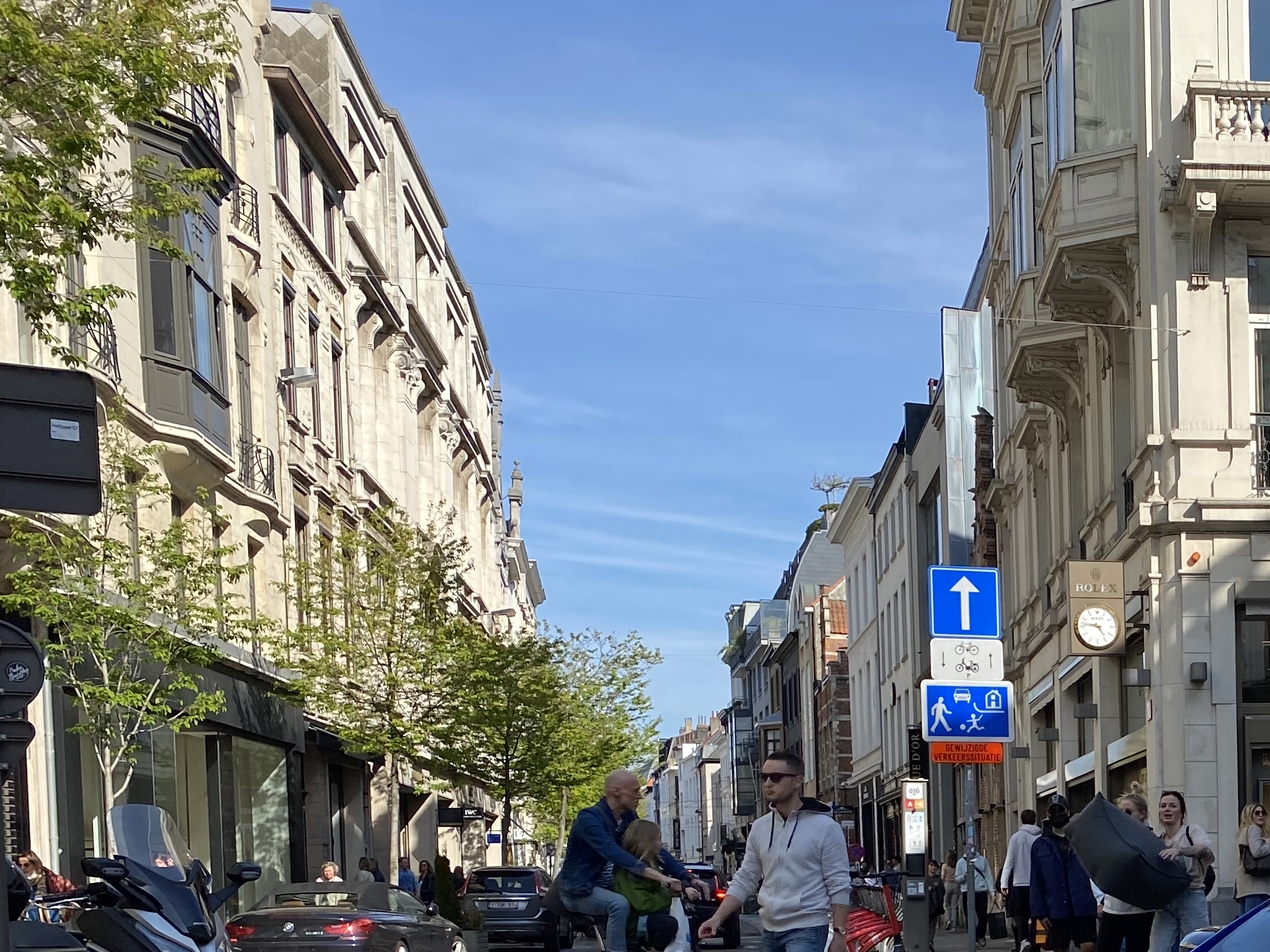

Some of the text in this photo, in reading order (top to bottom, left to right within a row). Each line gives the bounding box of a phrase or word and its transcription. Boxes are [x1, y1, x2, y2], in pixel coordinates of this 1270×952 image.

[1075, 583, 1118, 593] ROLEX
[945, 744, 988, 752] GEWIJZIGDE
[911, 733, 921, 778] UE D'OR
[933, 753, 1001, 762] VERKEERSSITUATIE
